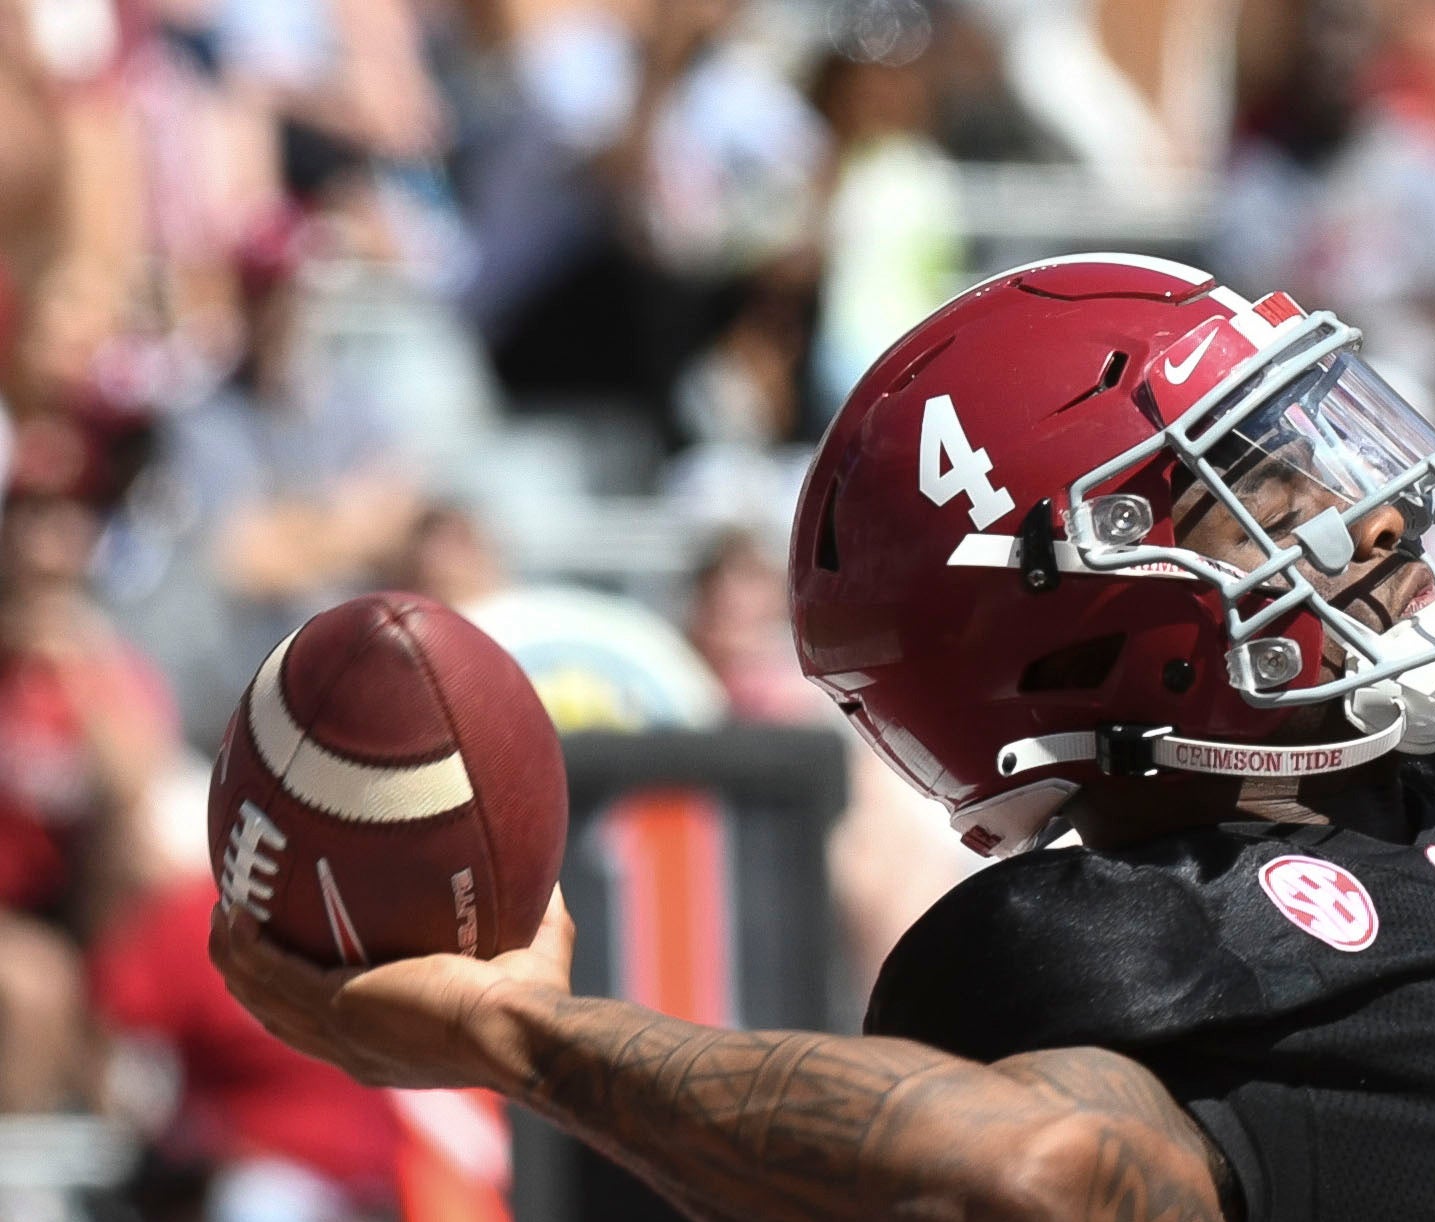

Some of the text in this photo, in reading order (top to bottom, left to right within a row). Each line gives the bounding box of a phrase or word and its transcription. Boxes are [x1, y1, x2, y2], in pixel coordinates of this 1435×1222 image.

[917, 395, 1017, 532] 4
[1176, 744, 1343, 772] CRIMSON TIDE
